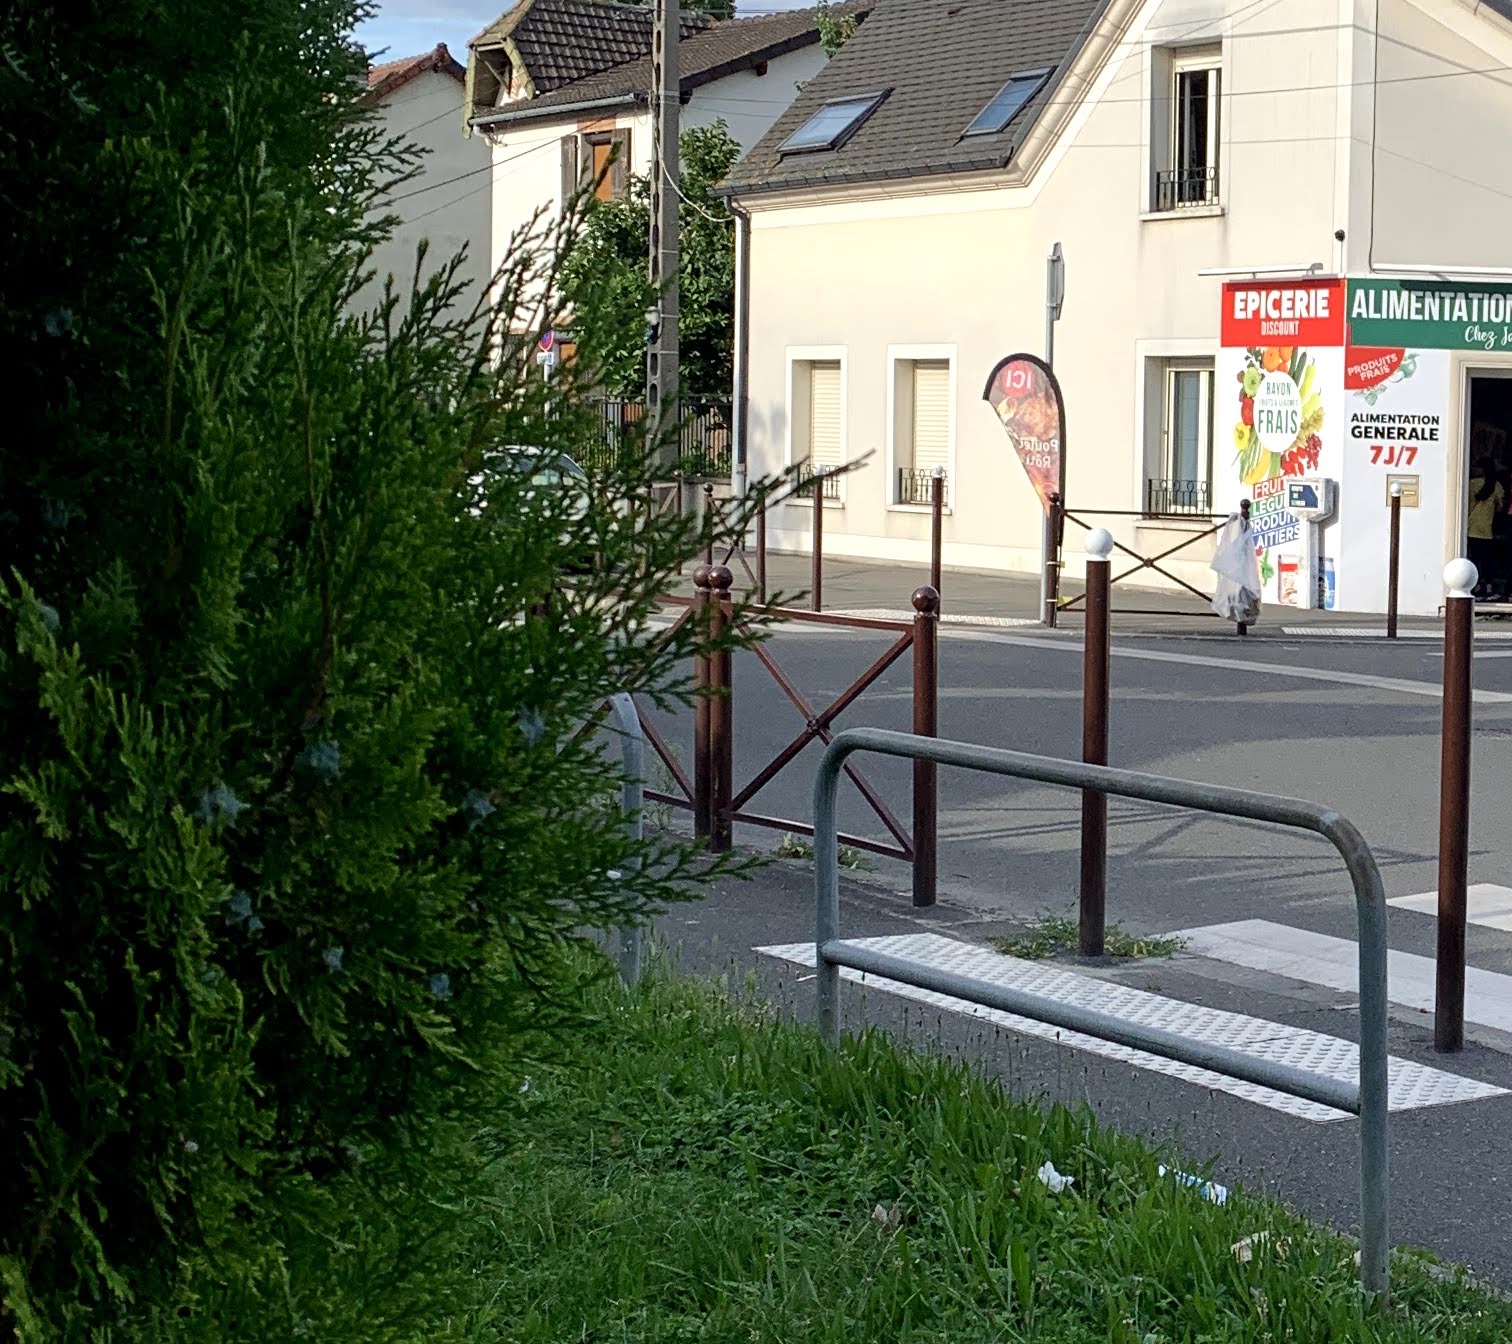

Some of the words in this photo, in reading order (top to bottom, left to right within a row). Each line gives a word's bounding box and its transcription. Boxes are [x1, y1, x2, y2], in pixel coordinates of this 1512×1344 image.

[1233, 288, 1330, 319] EPICERIE
[1261, 320, 1300, 335] DISCOUNT
[1464, 325, 1498, 349] Chez
[1347, 353, 1398, 376] PRODUITS
[1360, 364, 1391, 381] FRAIS
[1266, 382, 1292, 396] RAYON
[1258, 409, 1298, 434] FRAIS
[1351, 413, 1440, 425] ALIMENTATION
[1351, 425, 1439, 442] GENERALE
[1370, 445, 1419, 467] 7J/7
[1254, 476, 1287, 499] FRUIT
[1251, 511, 1298, 533] RODUI
[1256, 525, 1301, 548] AITIERS
